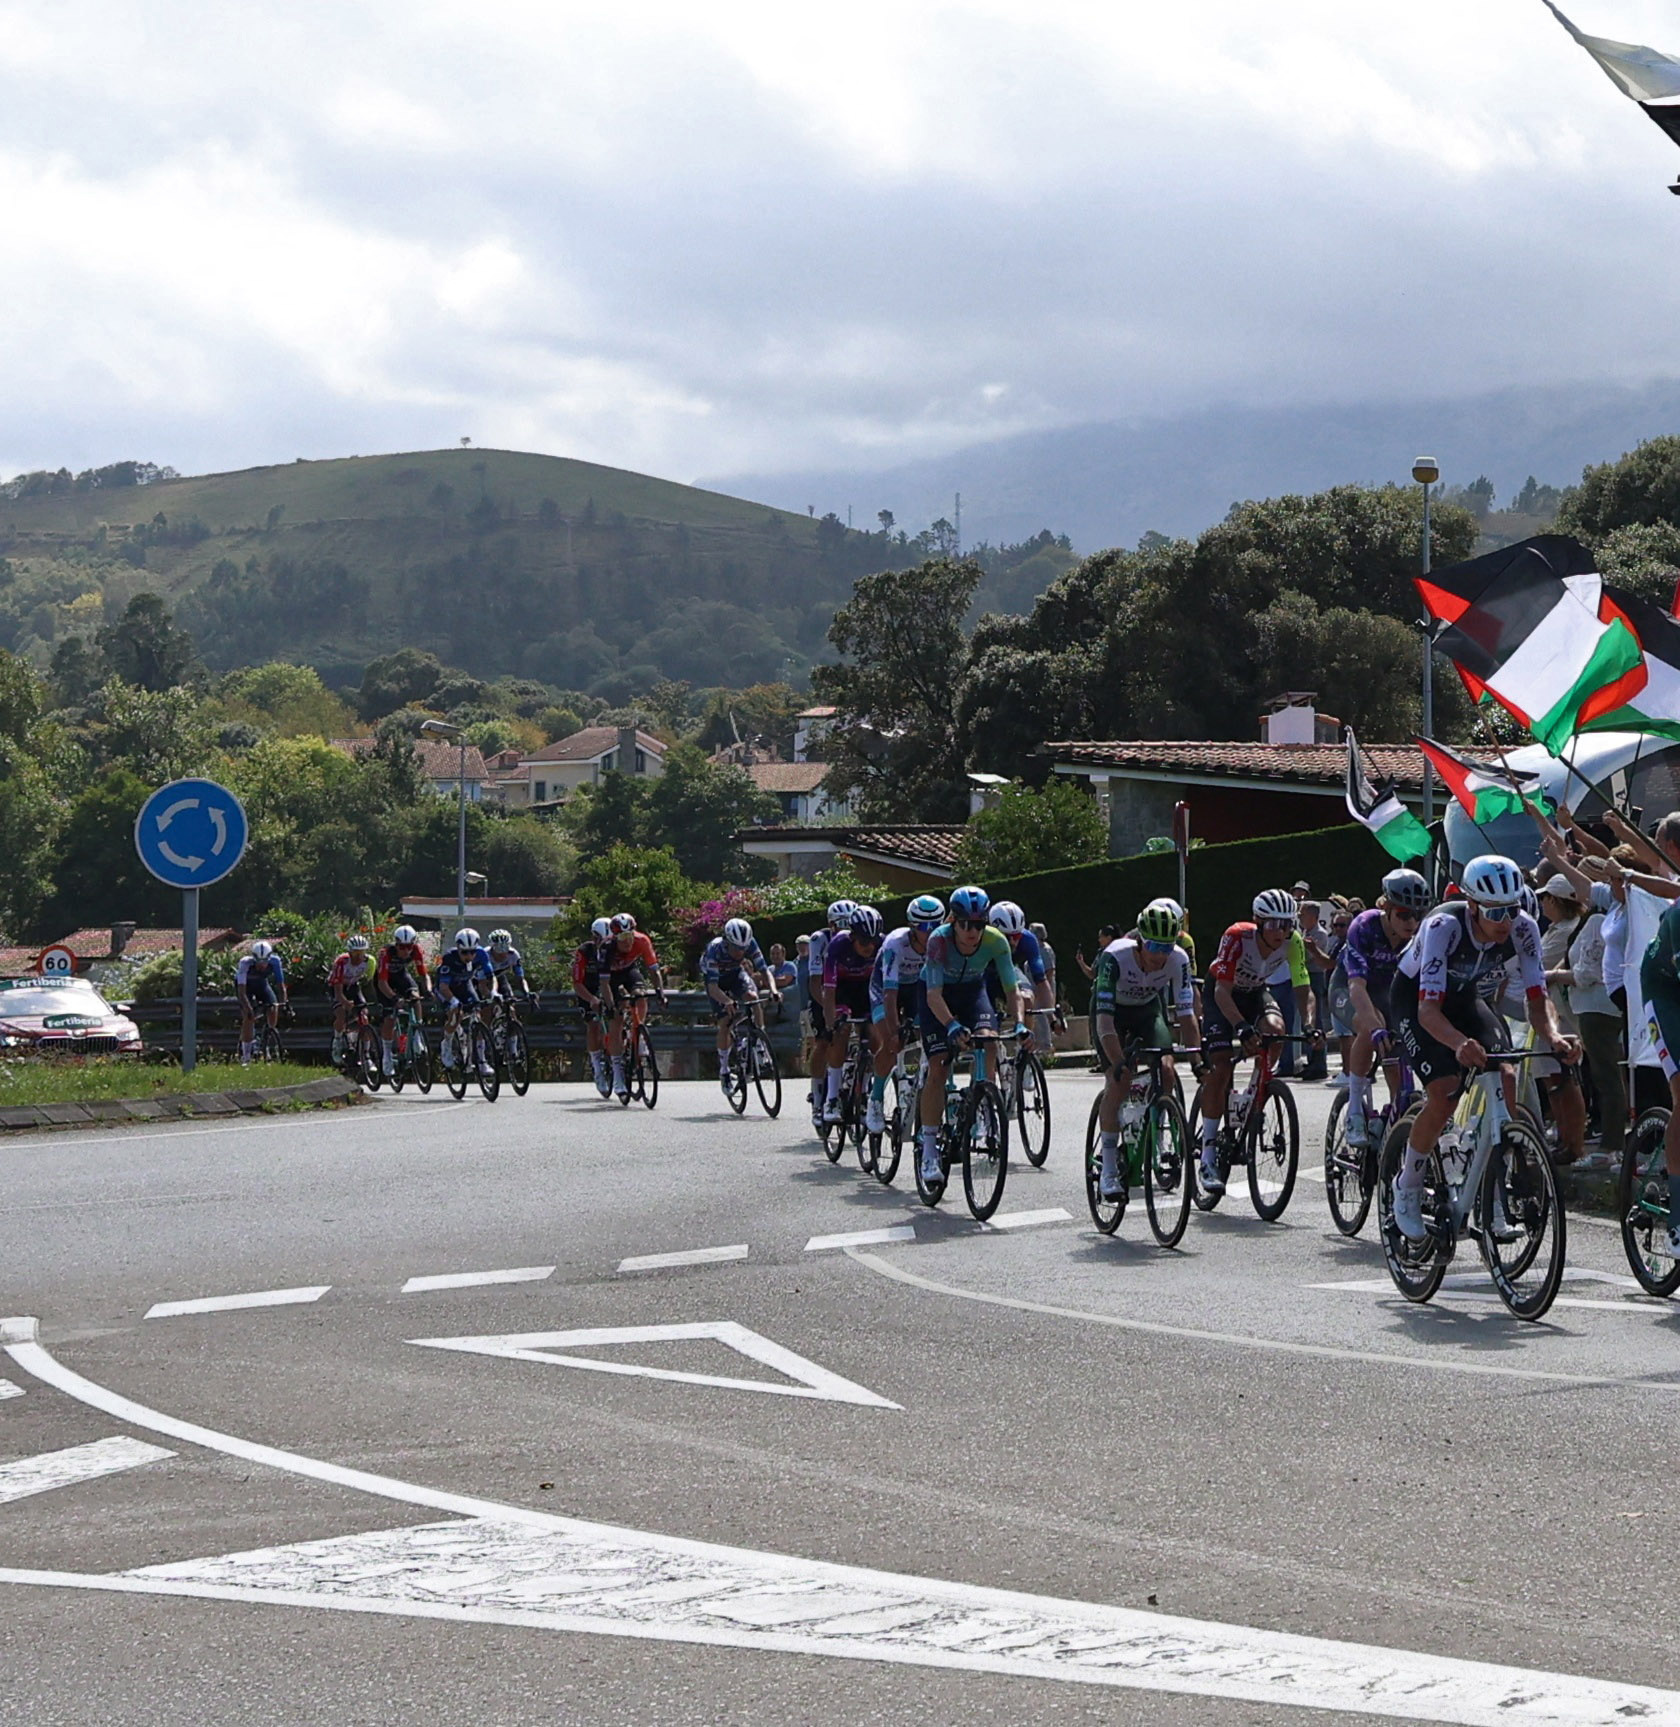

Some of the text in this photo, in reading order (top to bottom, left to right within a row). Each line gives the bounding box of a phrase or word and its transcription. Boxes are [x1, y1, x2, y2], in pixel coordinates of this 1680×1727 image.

[45, 957, 68, 971] 60
[12, 977, 74, 989] Fertiberia
[47, 1016, 102, 1028] Fertiberia
